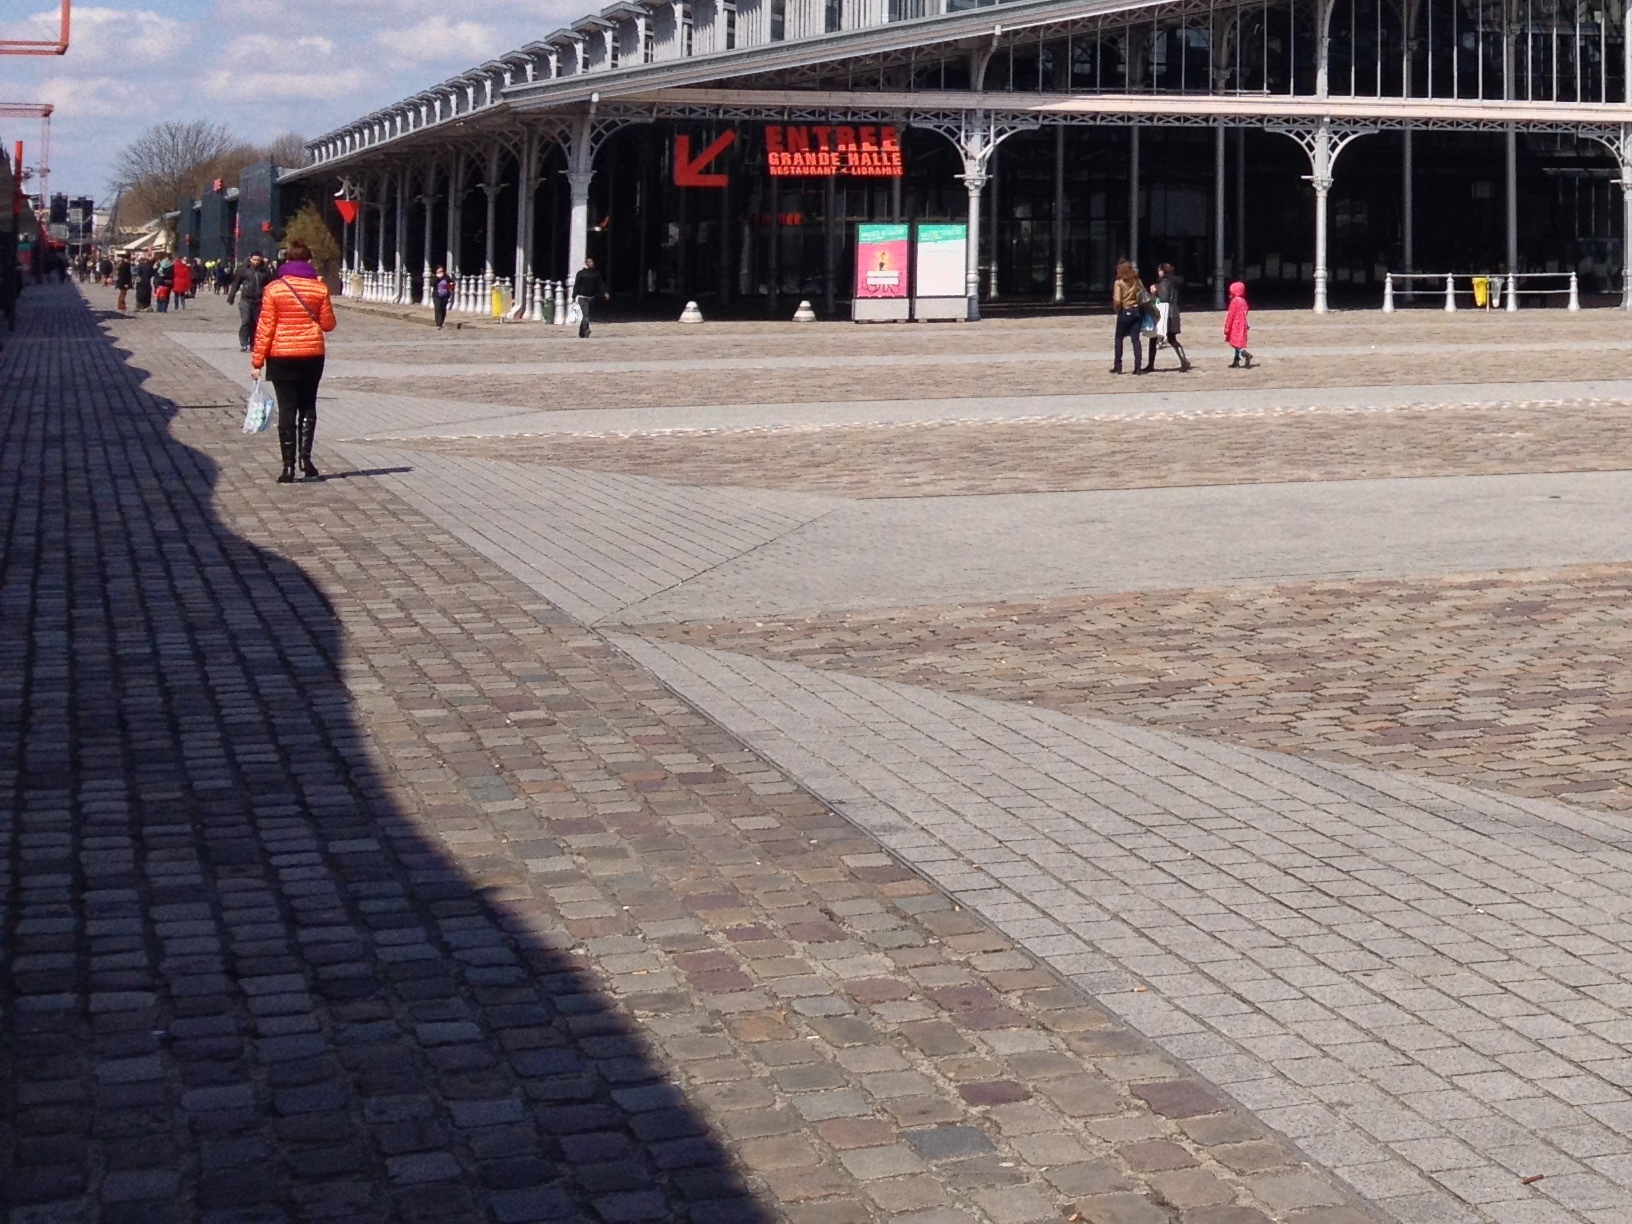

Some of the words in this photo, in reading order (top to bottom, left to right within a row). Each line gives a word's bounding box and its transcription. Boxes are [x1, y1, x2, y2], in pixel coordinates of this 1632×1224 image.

[765, 125, 900, 153] ENTREE
[768, 152, 840, 166] GRANDE
[848, 152, 902, 166] HALLE
[769, 166, 837, 176] RESTAURANT
